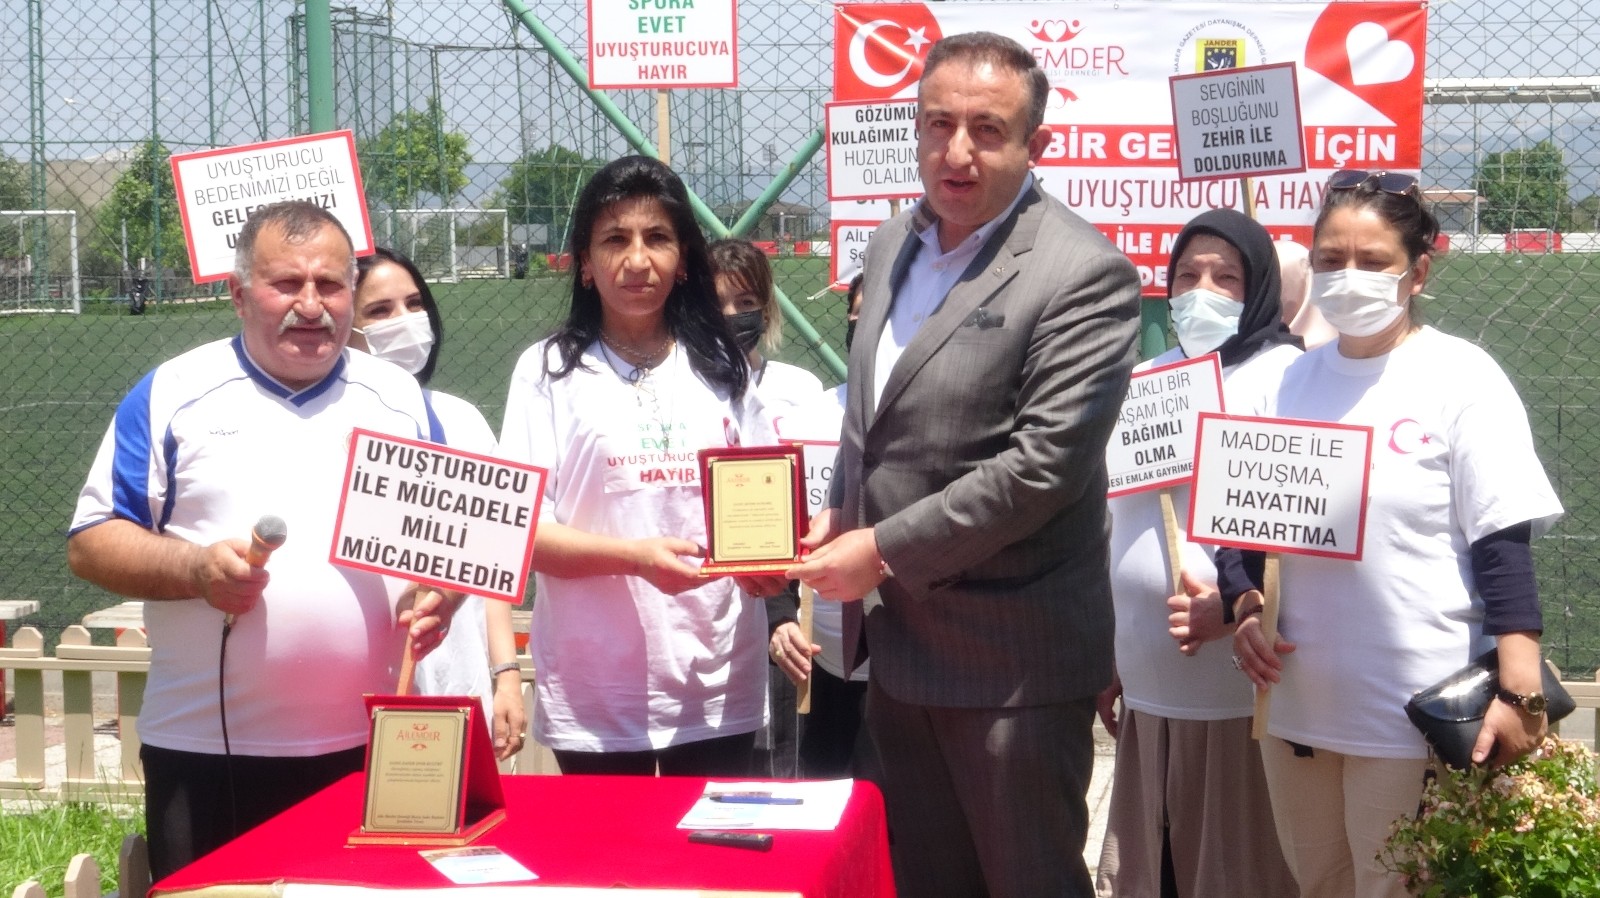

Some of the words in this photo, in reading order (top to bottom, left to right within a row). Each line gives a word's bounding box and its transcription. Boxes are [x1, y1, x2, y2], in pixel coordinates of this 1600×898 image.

[637, 15, 686, 34] EVET
[595, 40, 730, 61] UYUŞTURUCUYA
[638, 64, 688, 80] HAYIR
[1200, 75, 1265, 101] SEVGİNİN
[855, 102, 916, 123] GÖZÜMÜ
[1191, 101, 1279, 128] BOŞLUĞUNU
[831, 126, 909, 146] KULAĞIMIZ
[1042, 126, 1107, 159] BİR
[1314, 127, 1396, 168] İÇİN
[1202, 126, 1246, 148] ZEHİR
[1250, 124, 1273, 144] İLE
[206, 147, 324, 180] UYUŞTURUCU
[844, 147, 919, 167] HUZURUN
[1193, 149, 1288, 173] DOLDURUMA
[194, 174, 291, 206] BEDENİMİZİ
[296, 165, 346, 190] DEĞİL
[862, 167, 920, 185] OLALIM
[1067, 179, 1269, 217] UYUŞTURUCUA
[1280, 181, 1329, 210] HAY
[1116, 225, 1153, 254] İLE
[1167, 370, 1191, 391] BİR
[1117, 402, 1158, 427] AŞAM
[1160, 393, 1190, 418] İÇİN
[1121, 419, 1183, 446] BAĞIMLI
[1221, 430, 1303, 455] MADDE
[1310, 432, 1344, 459] İLE
[366, 439, 529, 494] UYUŞTURUCU
[607, 452, 695, 467] UYUŞTURUC
[1134, 444, 1177, 466] OLMA
[640, 468, 696, 482] HAYIR
[1126, 470, 1155, 485] EMLAK
[1156, 461, 1193, 478] GAYRİME
[1227, 459, 1330, 489] UYUŞMA,
[352, 465, 389, 498] İLE
[397, 480, 530, 528] MÜCADELE
[1226, 488, 1328, 516] HAYATINI
[401, 514, 468, 549] MİLLİ
[1211, 516, 1338, 547] KARARTMA
[341, 536, 515, 592] MÜCADELEDİR
